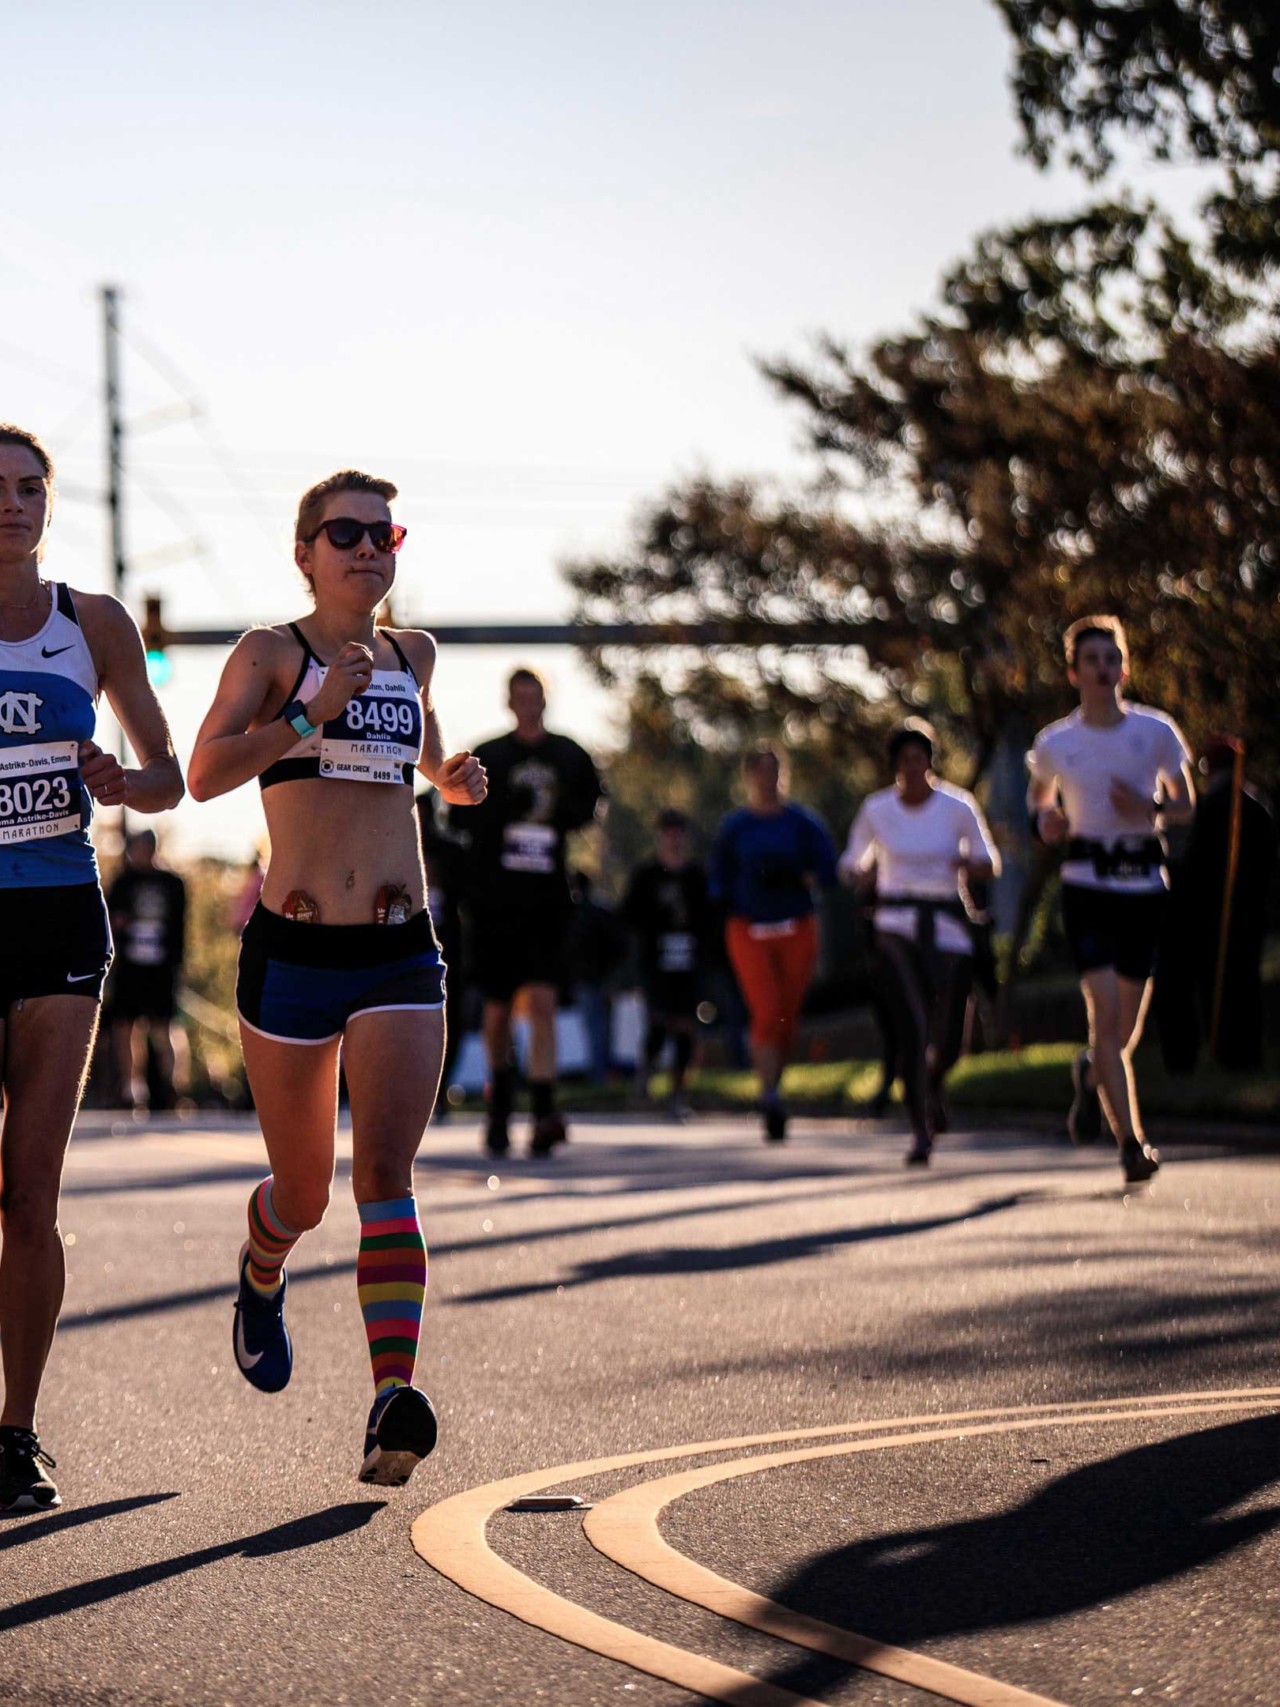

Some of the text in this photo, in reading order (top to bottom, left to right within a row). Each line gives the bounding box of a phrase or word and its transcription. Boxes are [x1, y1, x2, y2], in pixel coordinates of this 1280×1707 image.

[385, 683, 406, 694] Dahlia
[346, 699, 413, 735] 8499
[366, 733, 391, 741] Dahlia
[350, 743, 402, 756] MARATHON
[0, 758, 50, 772] Astrike-Davis,
[51, 754, 71, 765] Emma
[336, 763, 351, 772] GEAR
[352, 764, 371, 773] CHECK
[373, 770, 391, 780] 8499
[17, 809, 69, 823] Astrike-Davis
[2, 822, 59, 841] MARATHON
